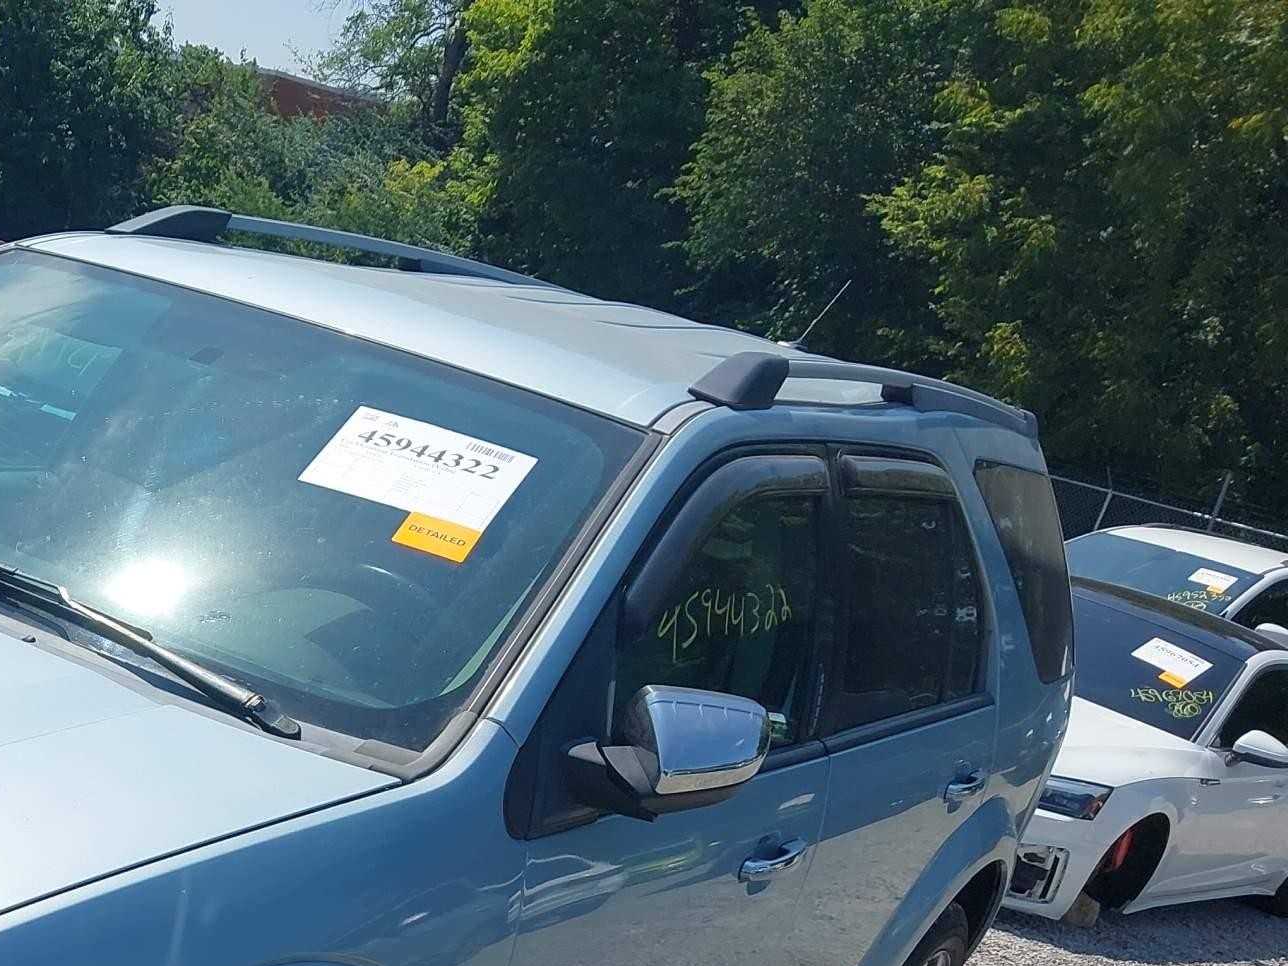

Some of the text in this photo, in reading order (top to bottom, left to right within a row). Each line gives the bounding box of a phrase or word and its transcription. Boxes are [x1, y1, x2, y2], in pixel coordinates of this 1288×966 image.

[357, 429, 500, 480] 45944322
[408, 523, 467, 548] DETAILED
[657, 583, 792, 663] 45944322
[1129, 687, 1213, 705] 45967054
